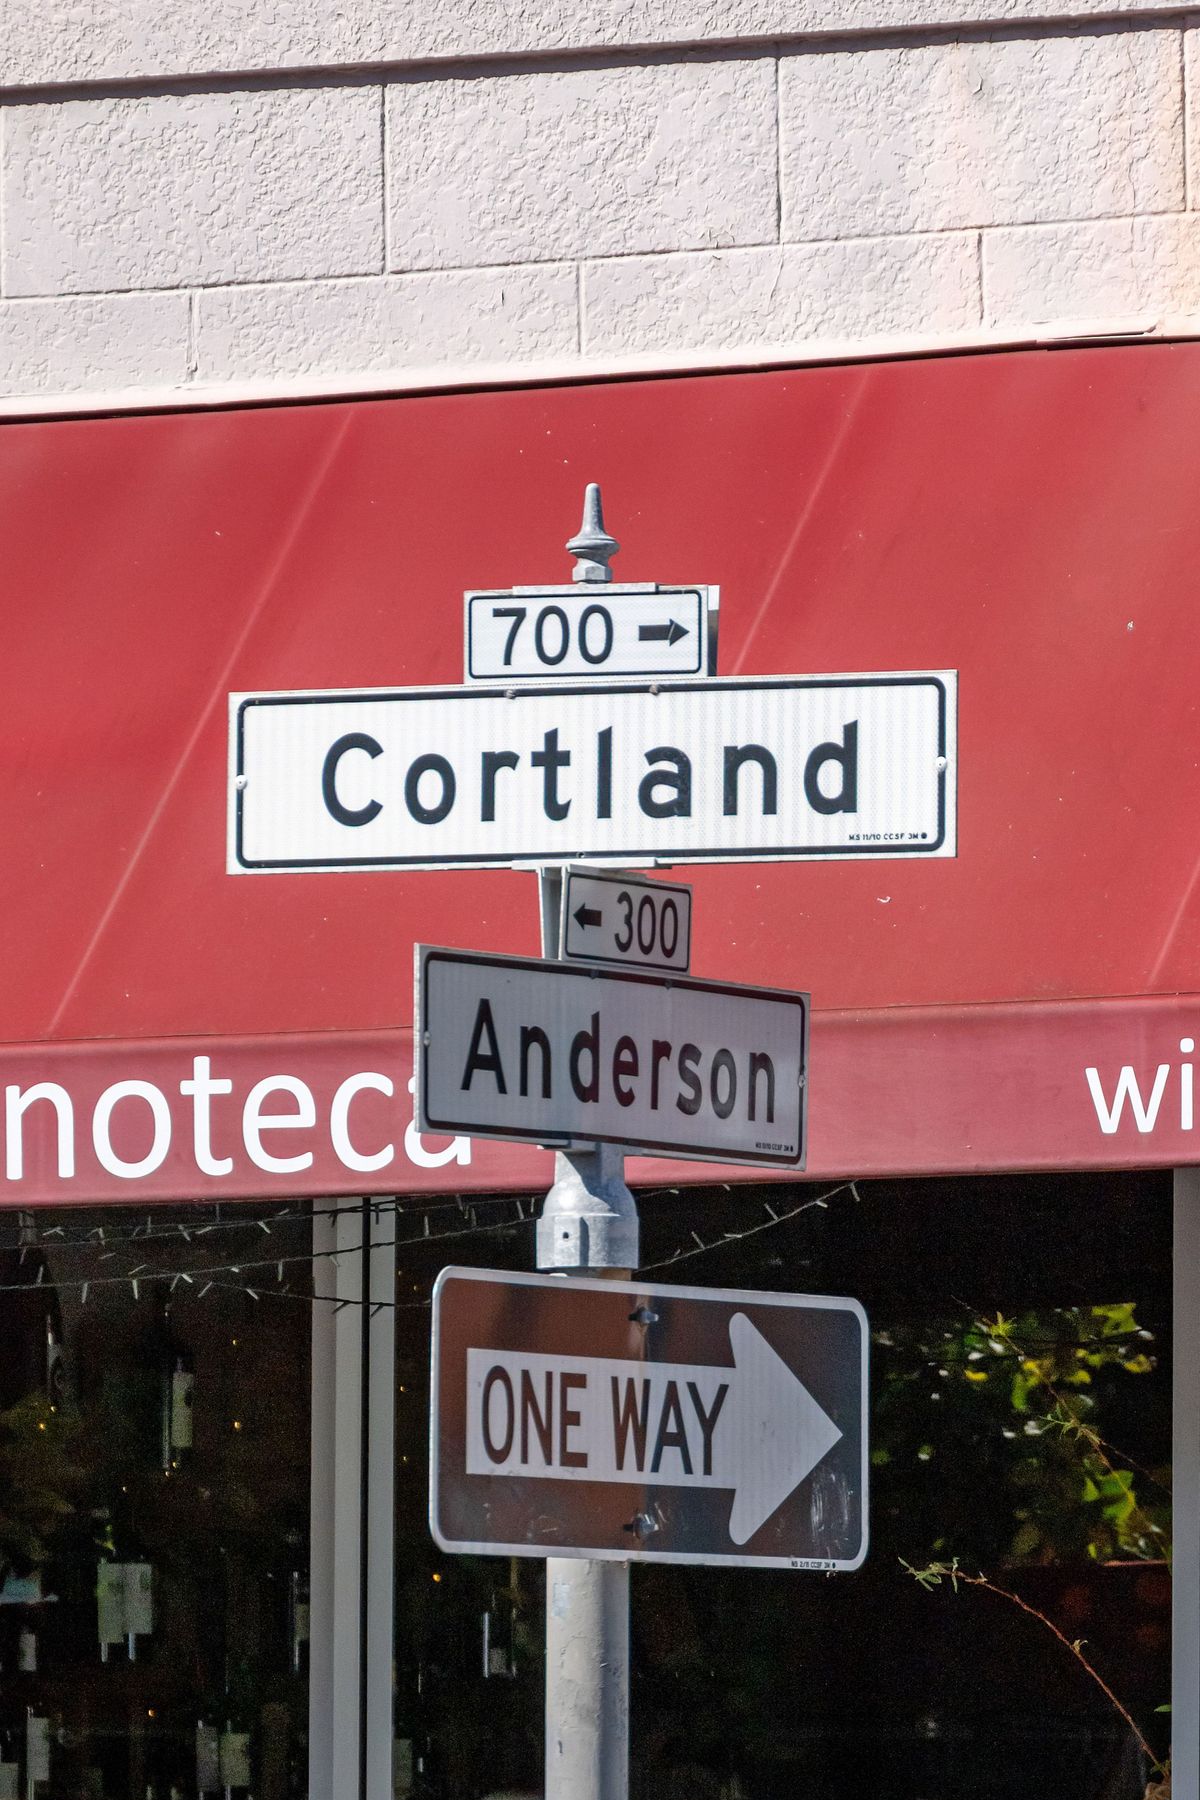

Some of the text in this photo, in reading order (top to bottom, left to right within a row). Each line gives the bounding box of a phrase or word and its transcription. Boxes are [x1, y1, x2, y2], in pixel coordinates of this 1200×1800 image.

[492, 604, 614, 666] 700
[322, 719, 858, 827] Cortland
[862, 833, 881, 841] 11/10
[883, 832, 905, 840] CCSF
[908, 832, 919, 840] 3M
[613, 890, 679, 959] 300
[460, 997, 776, 1124] Anderson
[482, 1364, 730, 1477] ONE WAY
